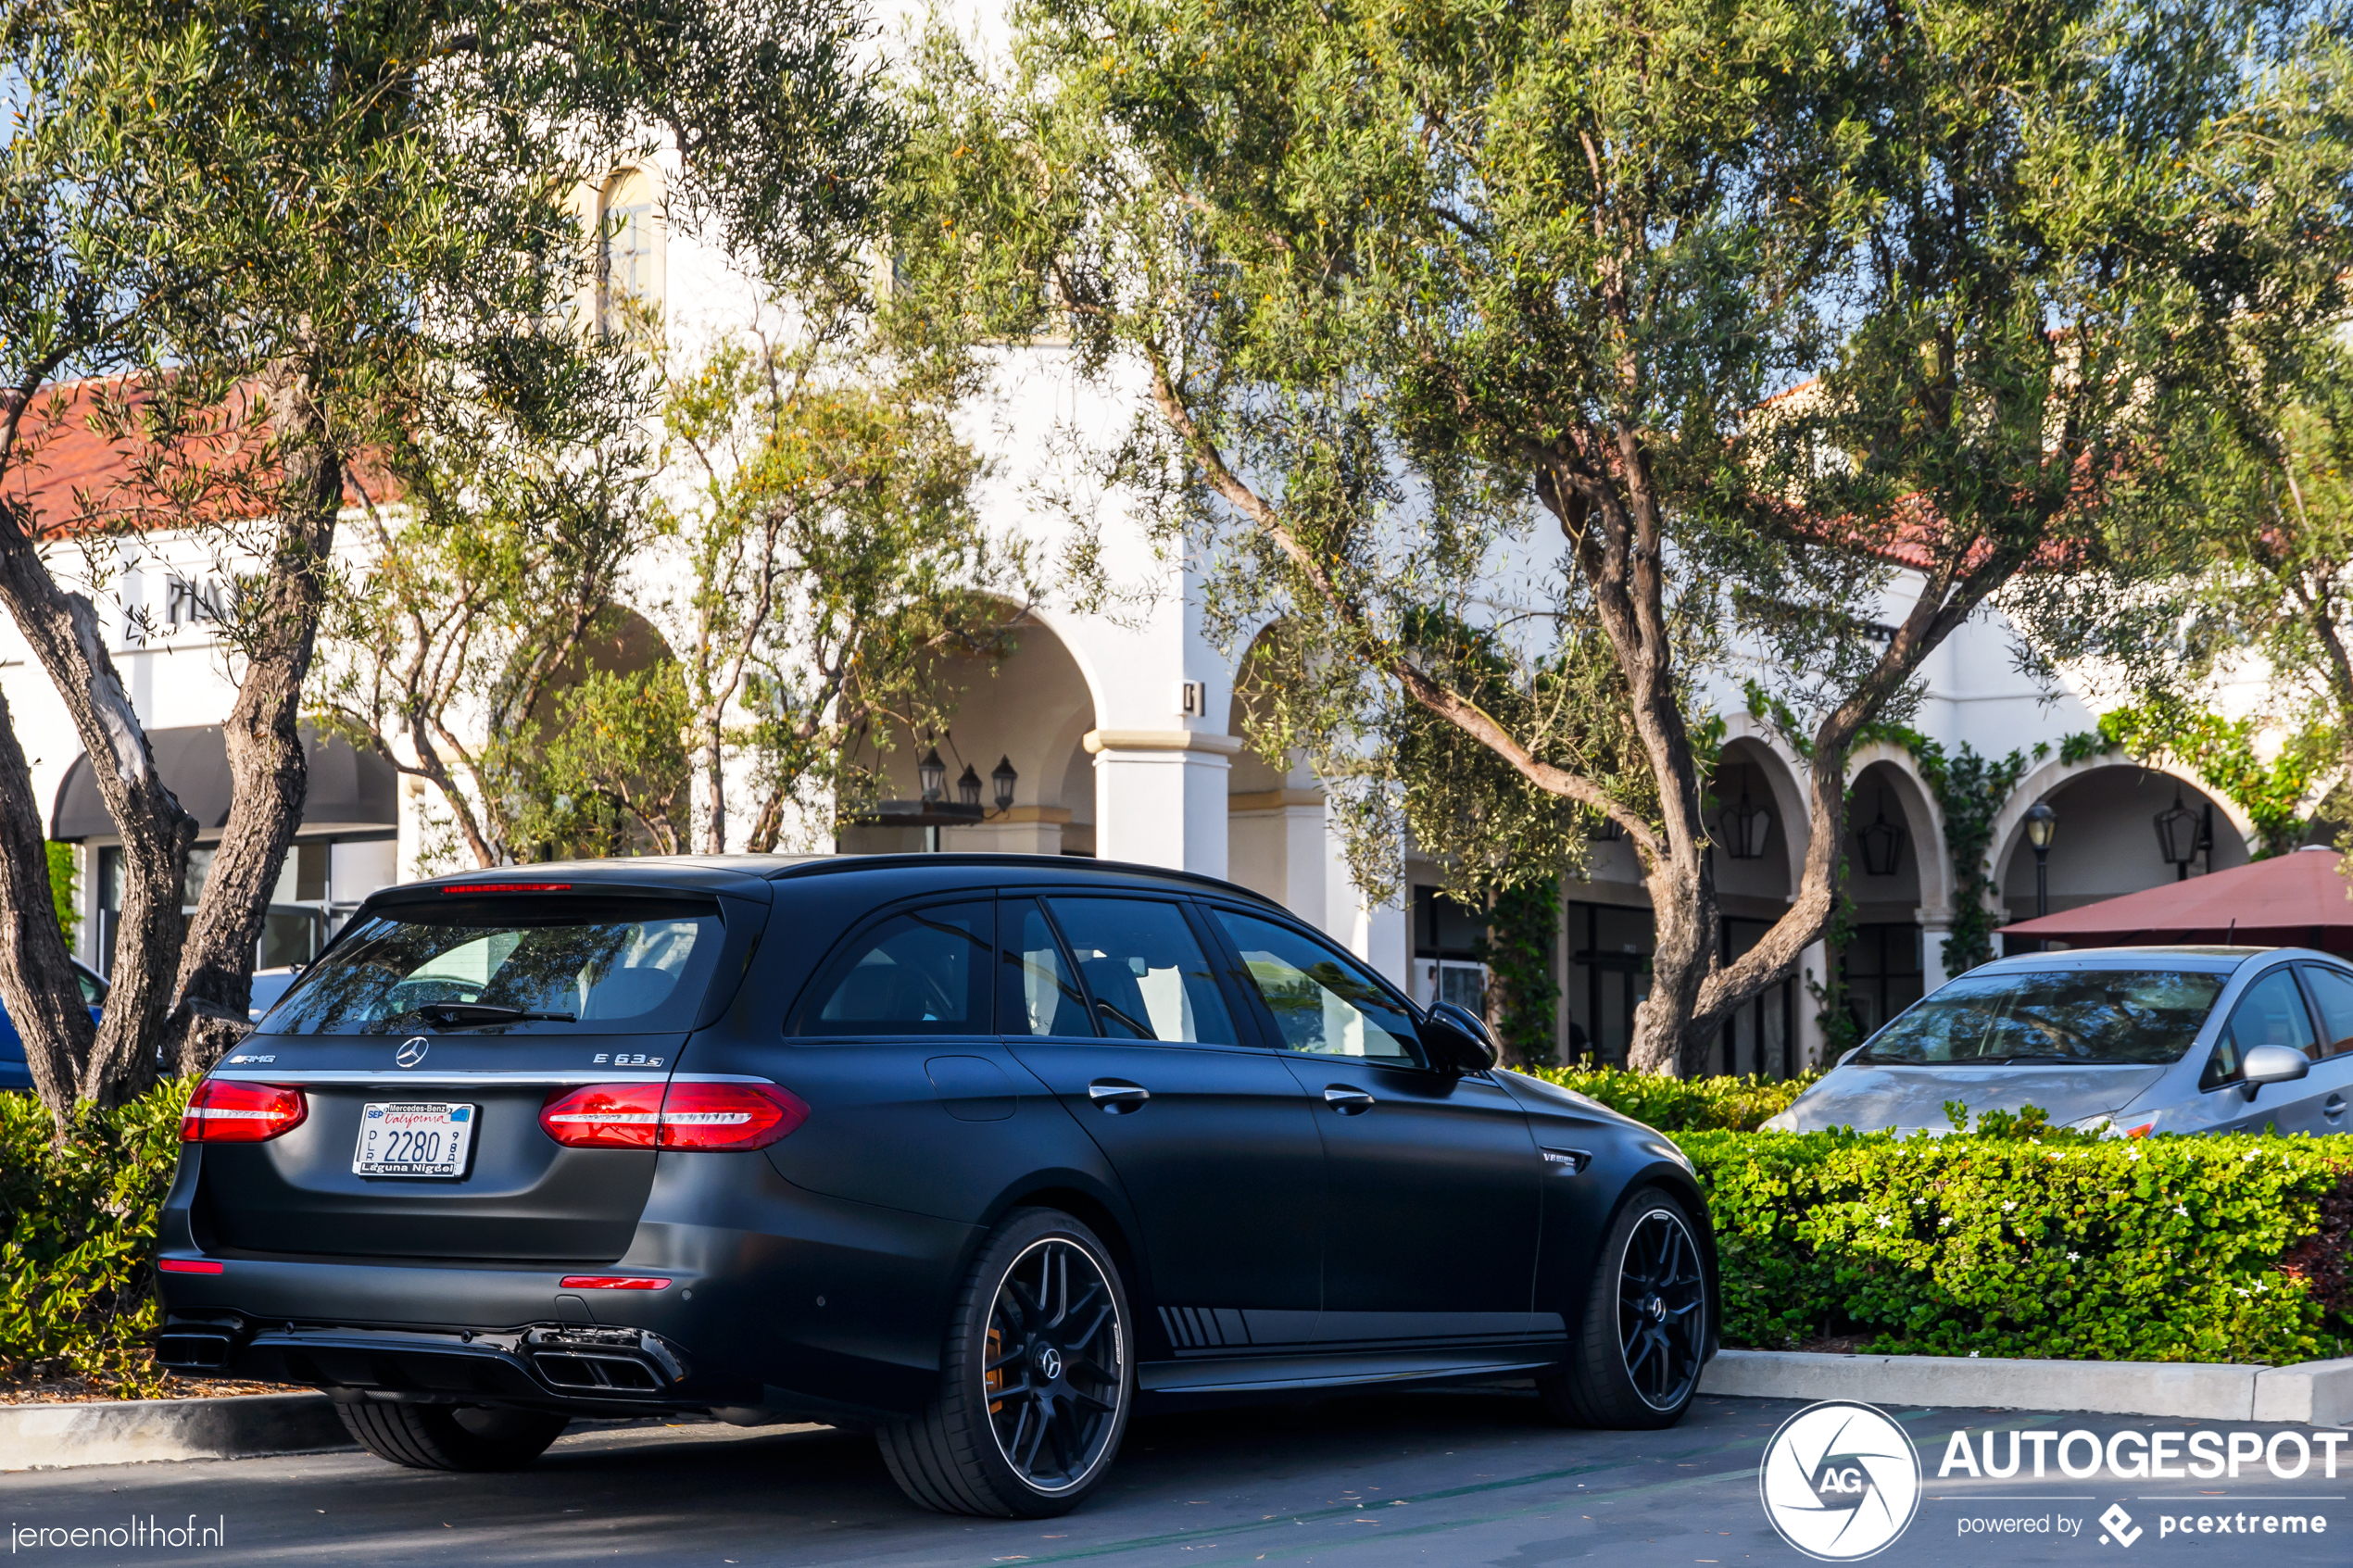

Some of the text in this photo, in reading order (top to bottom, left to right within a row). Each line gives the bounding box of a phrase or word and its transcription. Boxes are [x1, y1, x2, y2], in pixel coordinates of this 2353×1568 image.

[593, 1053, 610, 1063] E
[389, 1104, 447, 1112] Mercedes-Benz
[368, 1110, 384, 1119] SEP
[384, 1113, 451, 1129] California
[384, 1131, 440, 1162] 2280
[361, 1162, 454, 1174] Laguna Niguel
